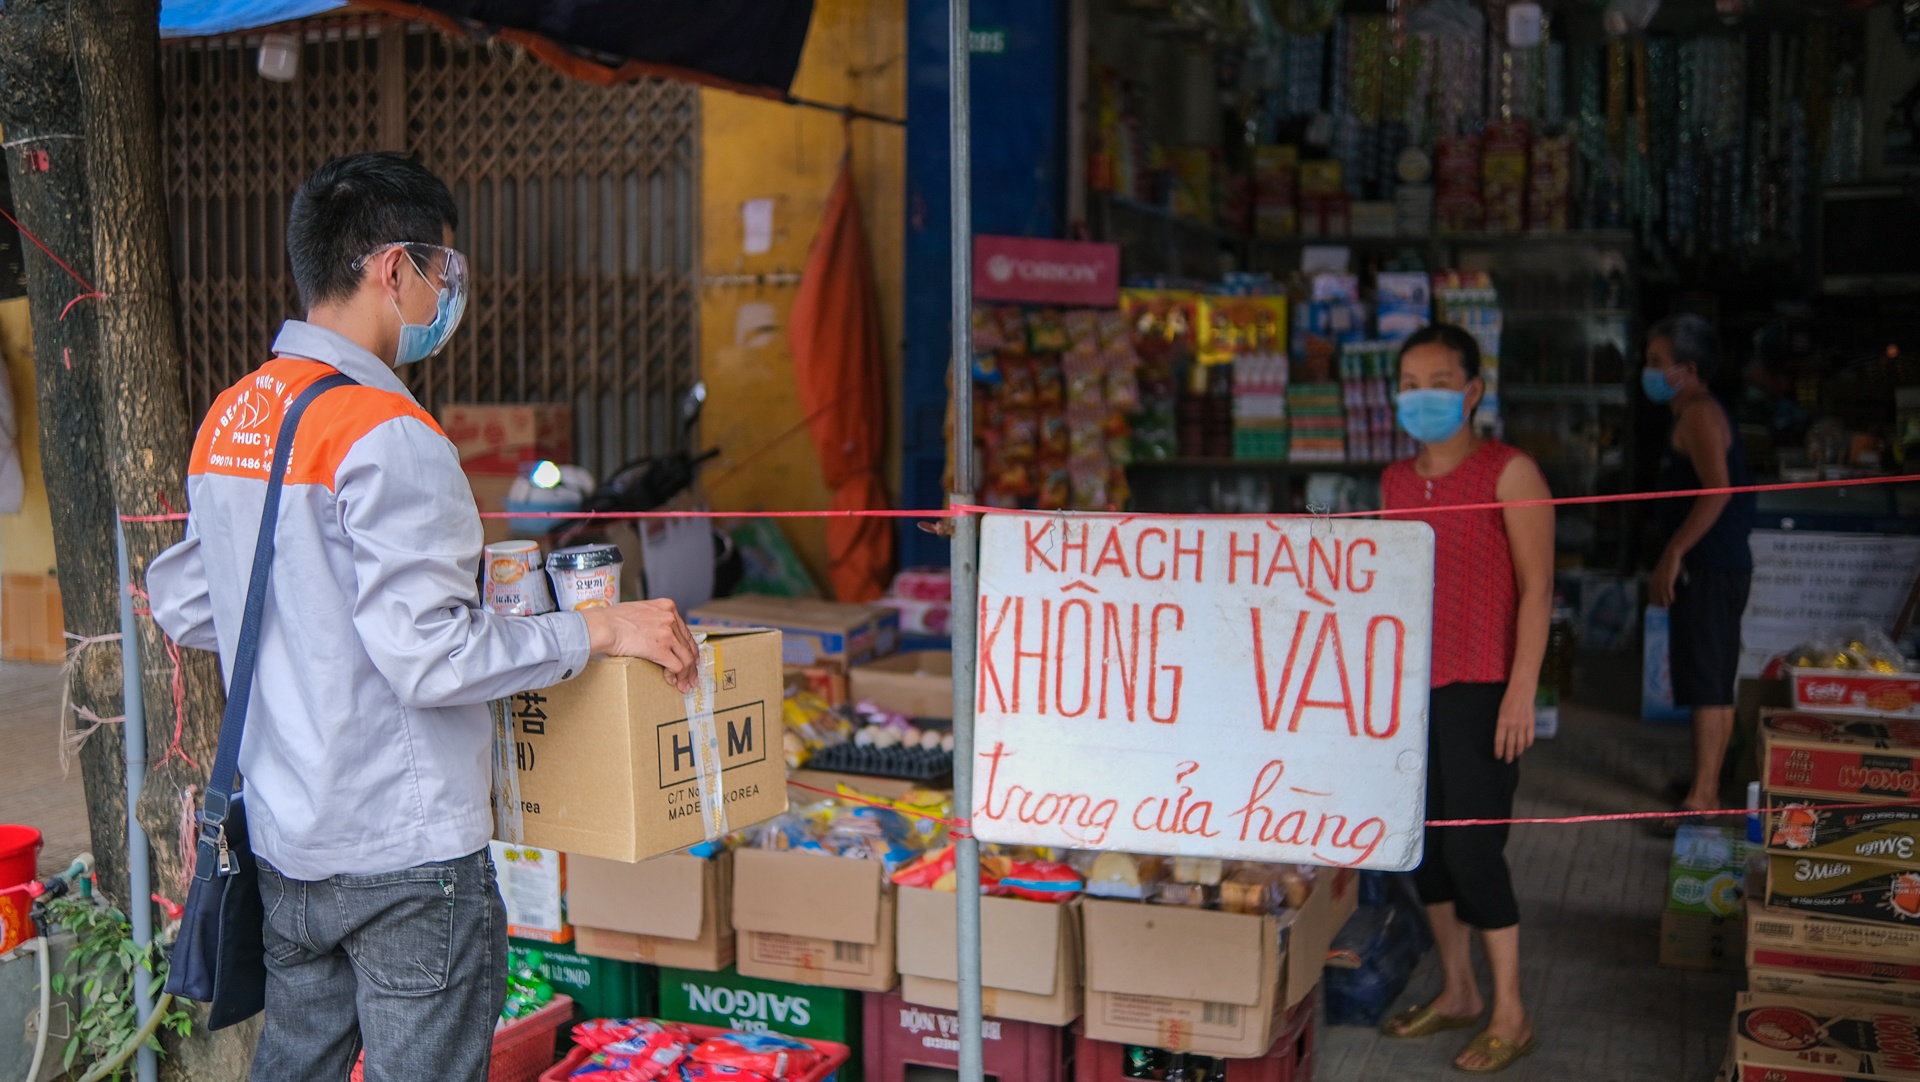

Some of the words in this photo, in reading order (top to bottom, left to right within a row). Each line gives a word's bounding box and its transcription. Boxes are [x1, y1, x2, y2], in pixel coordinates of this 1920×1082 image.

[236, 456, 260, 470] 1486
[1024, 517, 1204, 583] KHÁCH
[1229, 521, 1377, 594] HÀNG
[978, 580, 1184, 724] KHÔNG
[1250, 589, 1405, 739] VÀO
[669, 801, 701, 821] MADE
[722, 784, 759, 805] KOREA
[973, 741, 1118, 844] trong
[1132, 761, 1220, 839] cửa
[1228, 759, 1386, 867] hàng
[1897, 835, 1914, 859] 3
[1794, 858, 1812, 881] 3
